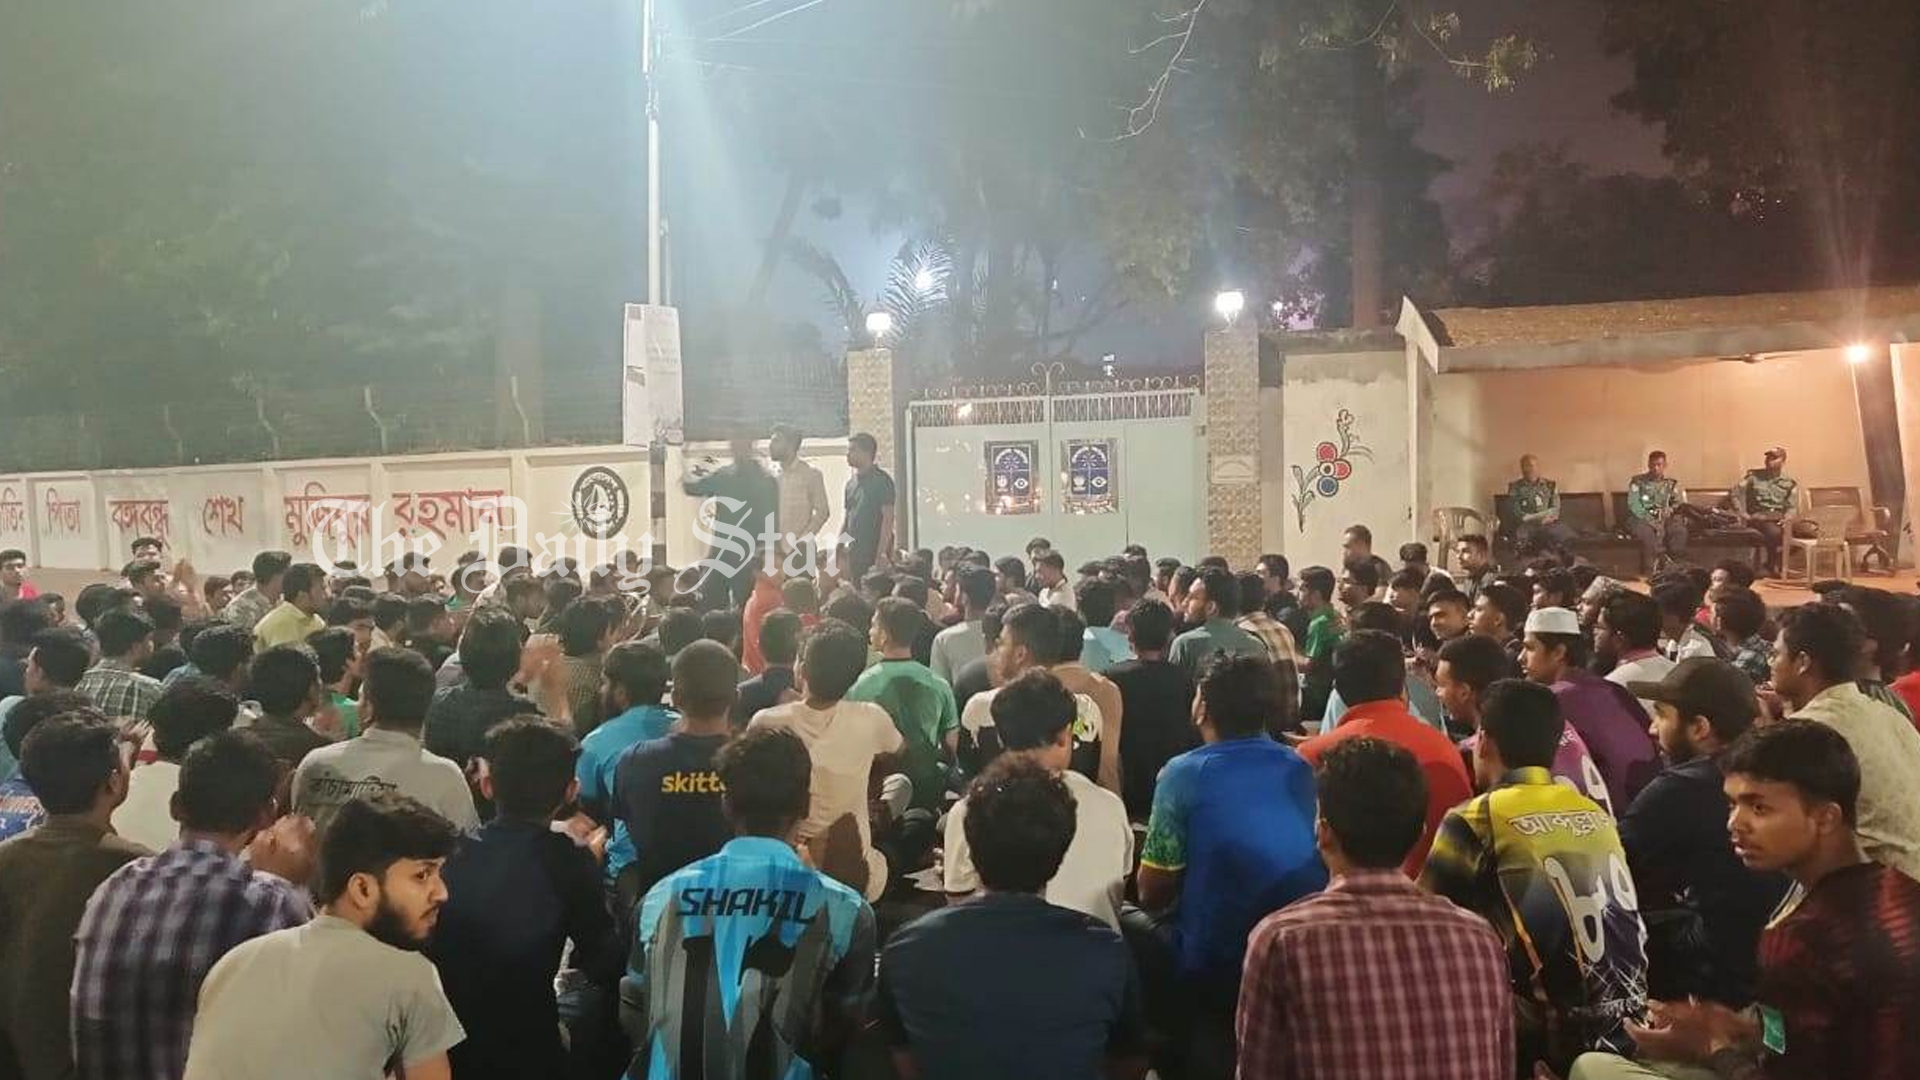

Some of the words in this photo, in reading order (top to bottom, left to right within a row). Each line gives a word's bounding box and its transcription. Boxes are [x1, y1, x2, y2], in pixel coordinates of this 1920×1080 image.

[203, 496, 244, 535] শেখ
[660, 771, 727, 793] skitt
[677, 886, 816, 925] SHAKIL
